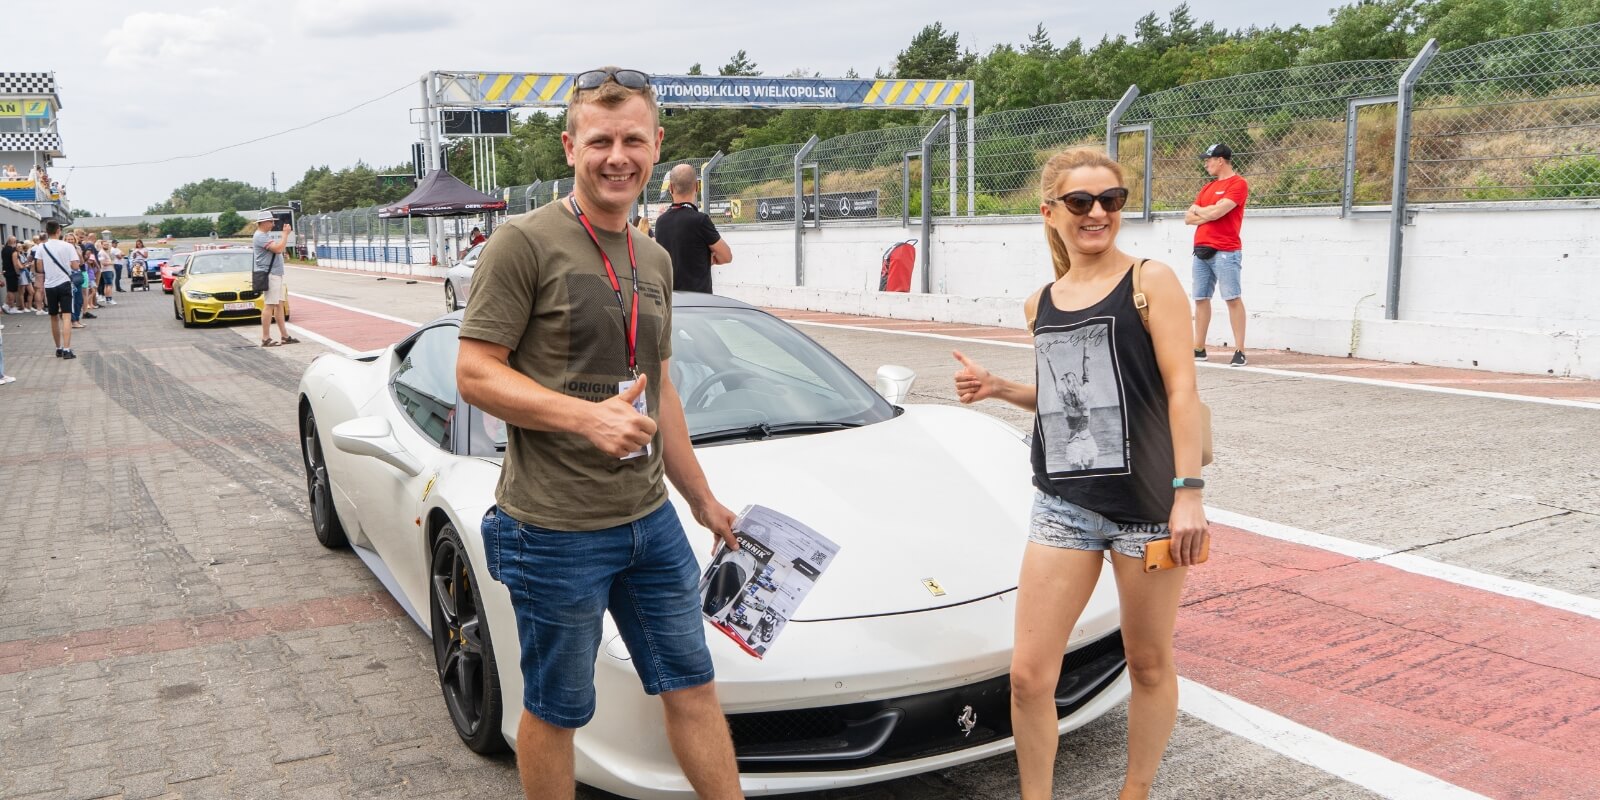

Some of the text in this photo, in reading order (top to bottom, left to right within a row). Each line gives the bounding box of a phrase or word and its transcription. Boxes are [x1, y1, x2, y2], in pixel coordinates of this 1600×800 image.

[651, 84, 835, 98] AUTOMOBILKLUB WIELKOPOLSKI
[736, 536, 766, 559] CENNIK
